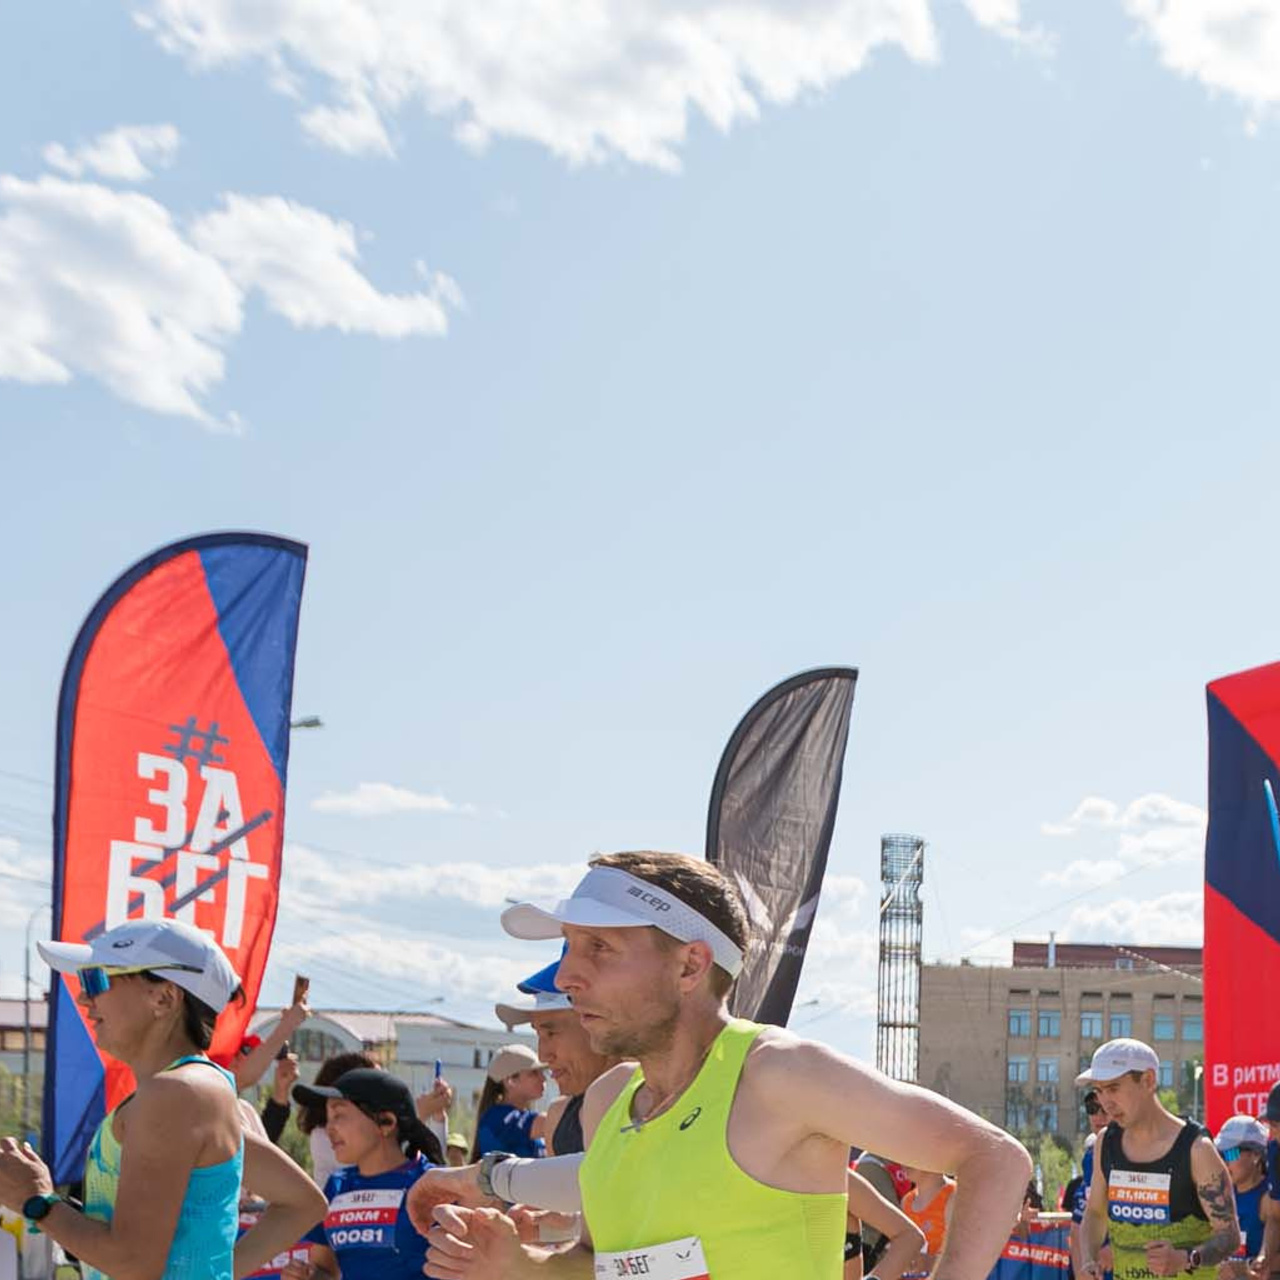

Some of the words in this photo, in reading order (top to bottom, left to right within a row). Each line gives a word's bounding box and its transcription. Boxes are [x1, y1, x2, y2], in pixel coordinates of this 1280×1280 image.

[134, 752, 250, 861] ЗА
[105, 839, 269, 949] БЕГ
[1213, 1063, 1229, 1086] В
[1112, 1205, 1166, 1220] 00036
[330, 1229, 384, 1245] 10081
